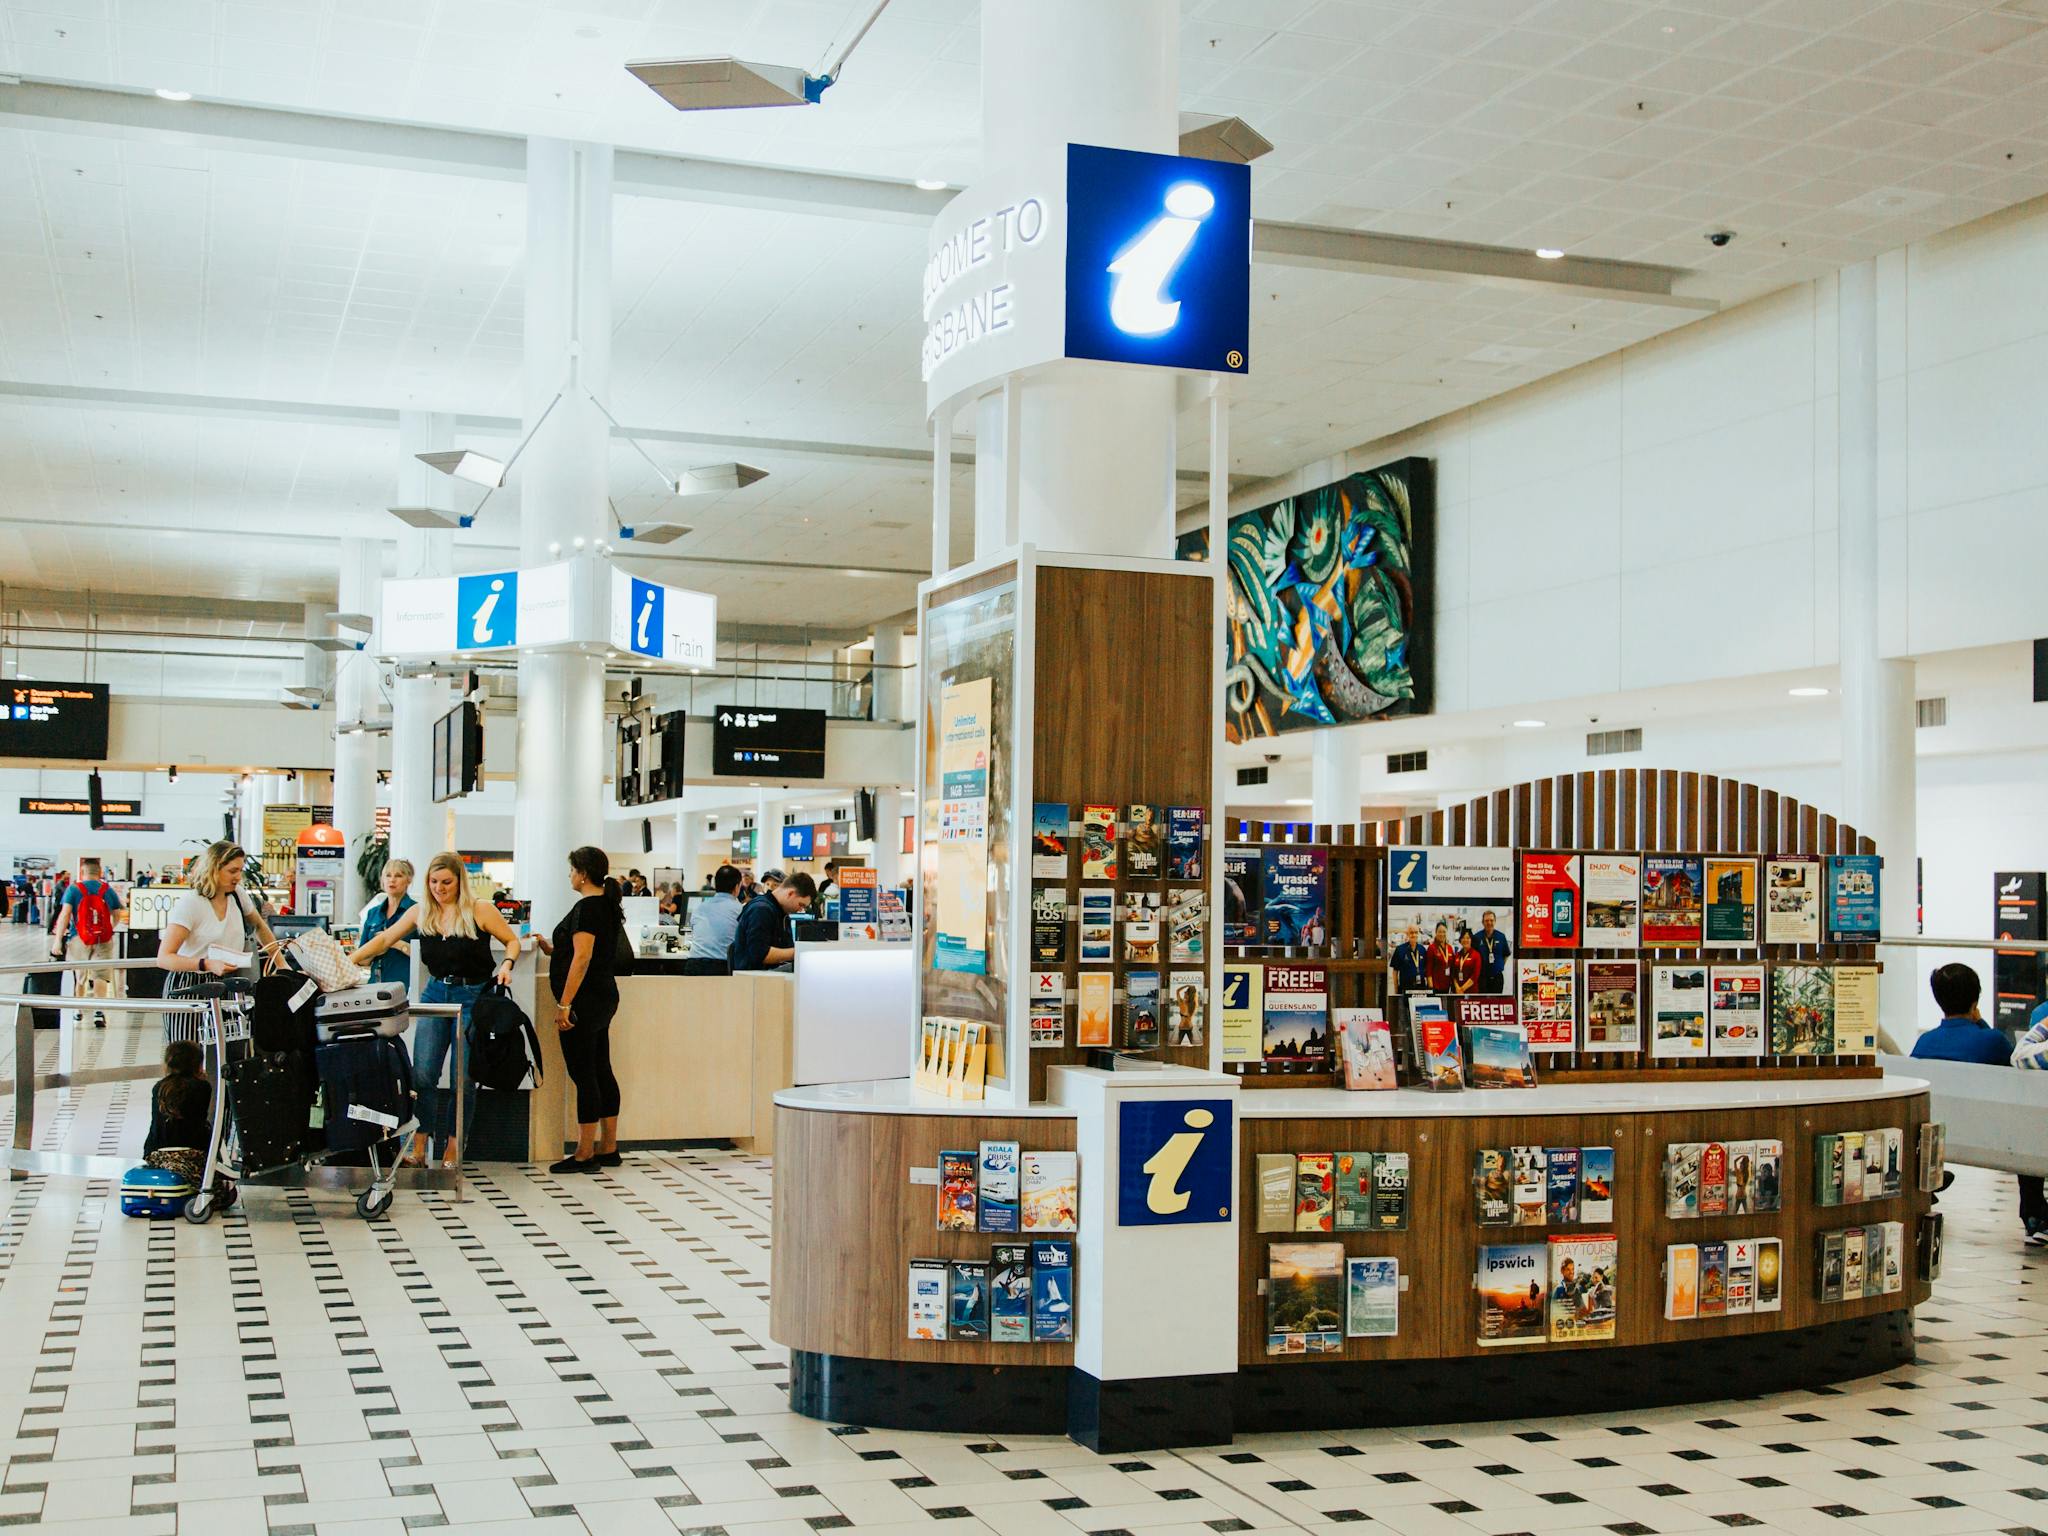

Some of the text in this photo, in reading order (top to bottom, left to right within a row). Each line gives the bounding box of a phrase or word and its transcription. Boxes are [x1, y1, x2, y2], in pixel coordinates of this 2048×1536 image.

[997, 199, 1042, 250] TO
[672, 634, 703, 658] Train
[1173, 829, 1199, 838] Jurassic
[1273, 873, 1318, 885] Jurassic
[1282, 884, 1309, 896] Seas
[1036, 909, 1065, 920] LOST
[1526, 904, 1549, 918] 9GB
[1268, 970, 1314, 988] FREE!
[1460, 1003, 1505, 1021] FREE!
[987, 1145, 1013, 1153] KOALA
[987, 1153, 1012, 1161] CRUISE
[945, 1161, 973, 1171] OPAL
[1378, 1176, 1408, 1187] LOST
[1552, 1173, 1576, 1181] Jurassic
[1556, 1242, 1614, 1257] DAY TOURS
[1486, 1255, 1535, 1272] Ipswich
